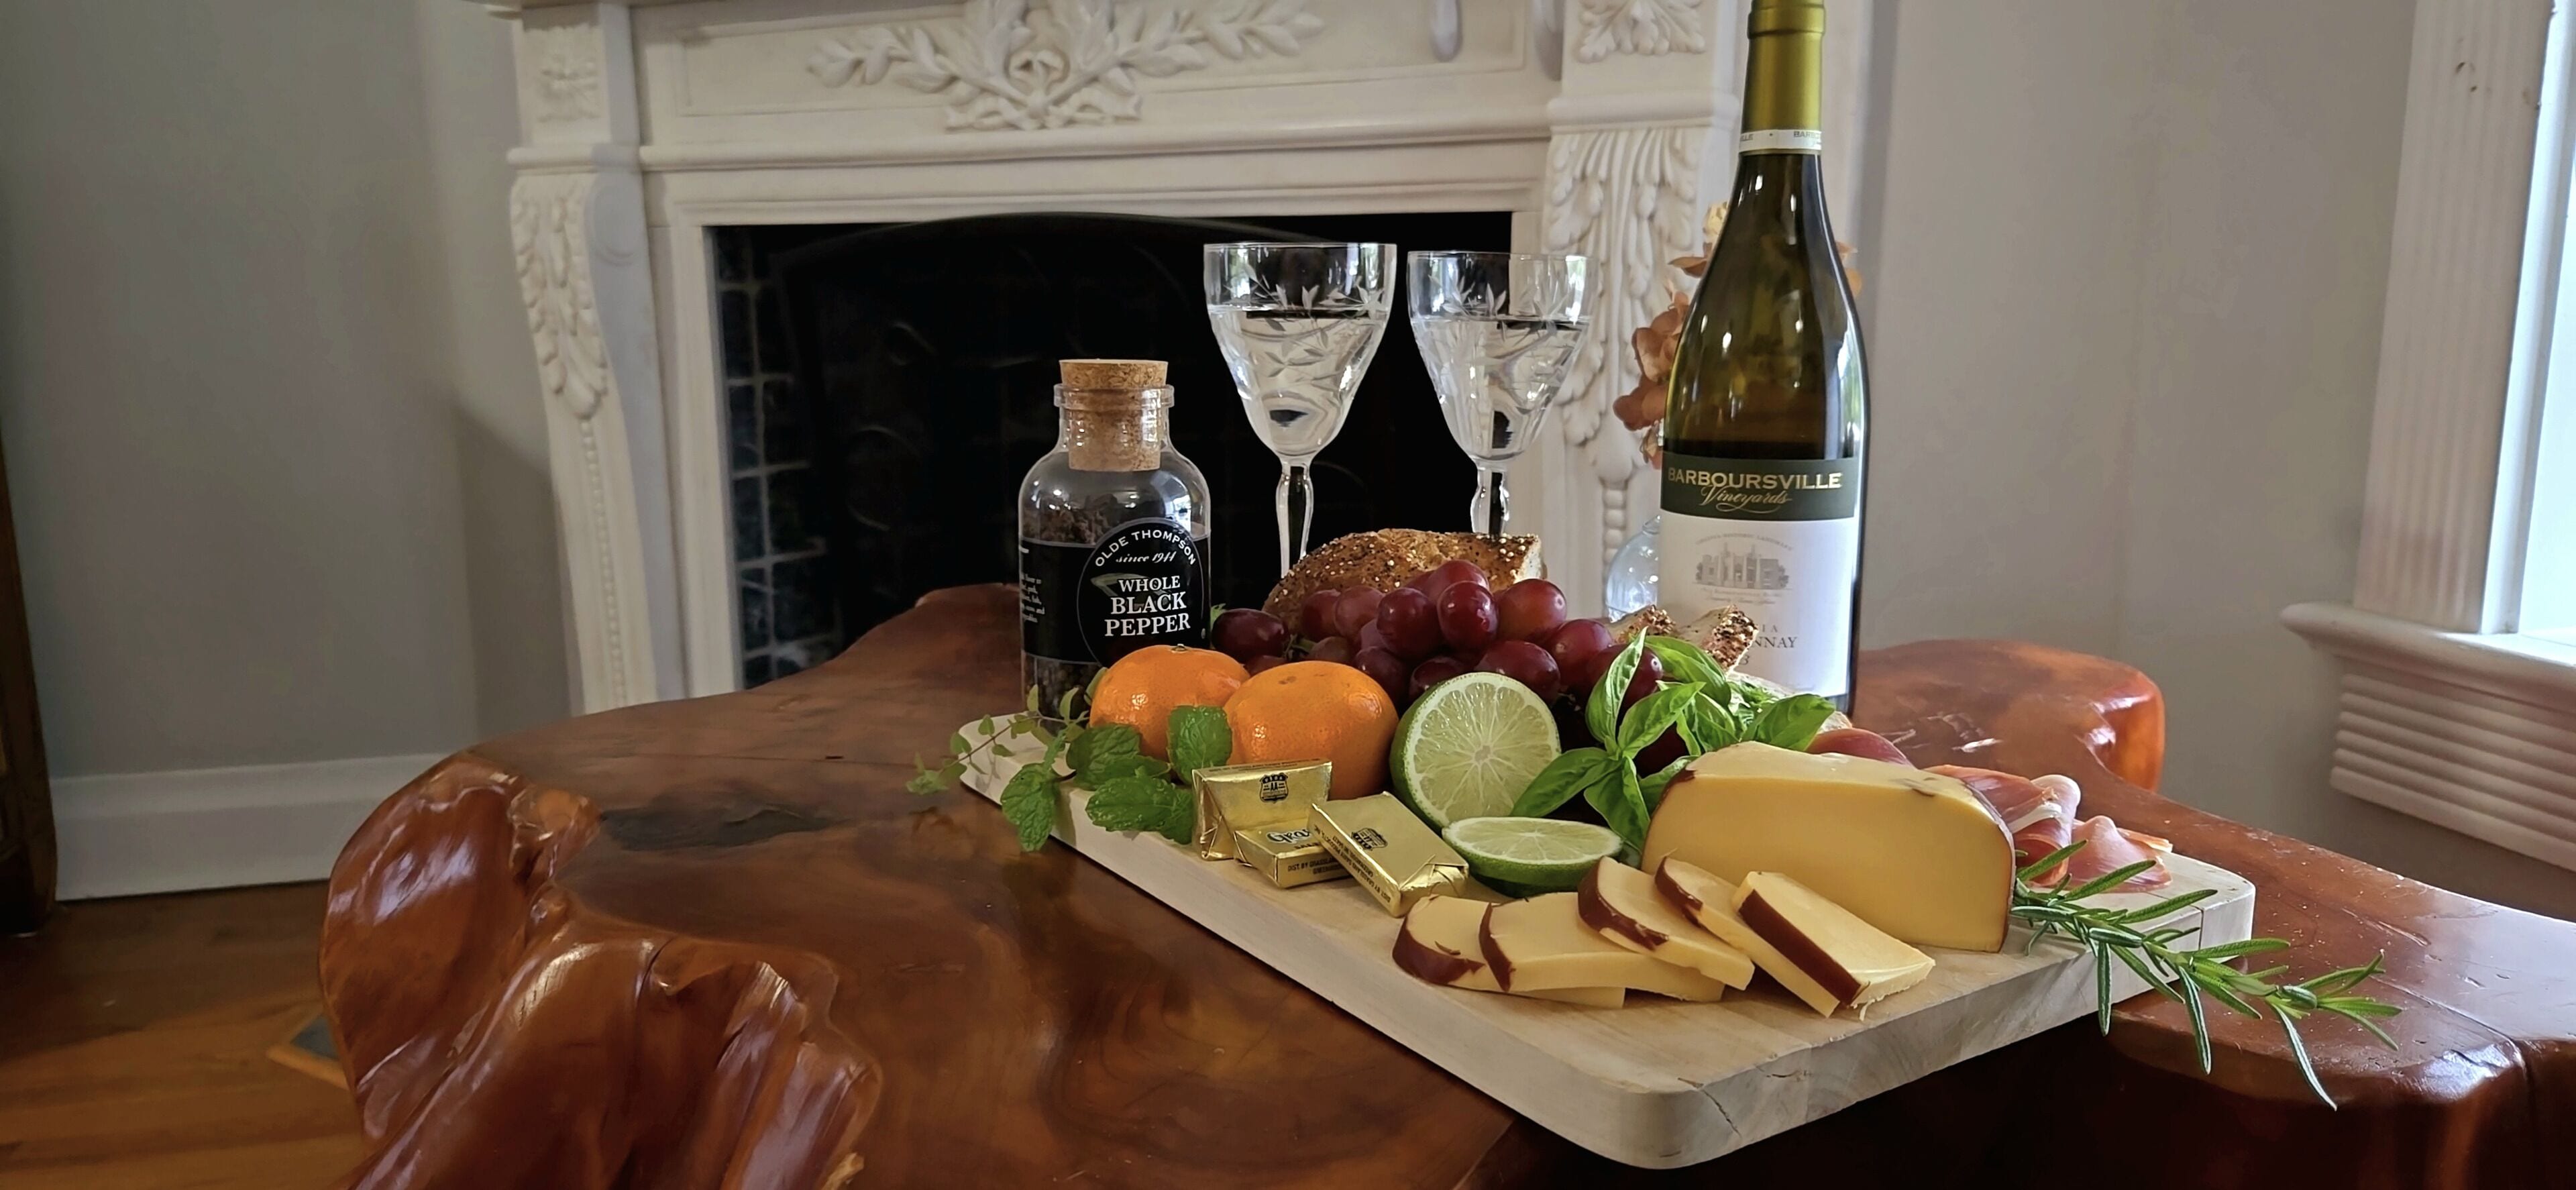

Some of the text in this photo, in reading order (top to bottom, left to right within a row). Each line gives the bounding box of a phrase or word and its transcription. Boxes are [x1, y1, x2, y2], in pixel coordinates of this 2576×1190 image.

[1668, 468, 1843, 490] BARBOURSVILLE
[1699, 486, 1792, 514] Vineyards
[1095, 530, 1196, 566] OLDE THOMPSON
[1116, 553, 1149, 563] since
[1118, 576, 1181, 592] WHOLE
[1110, 591, 1187, 614] BLACK
[1104, 612, 1191, 637] PEPPER
[1754, 636, 1798, 649] NNAY
[1301, 862, 1308, 870] BY
